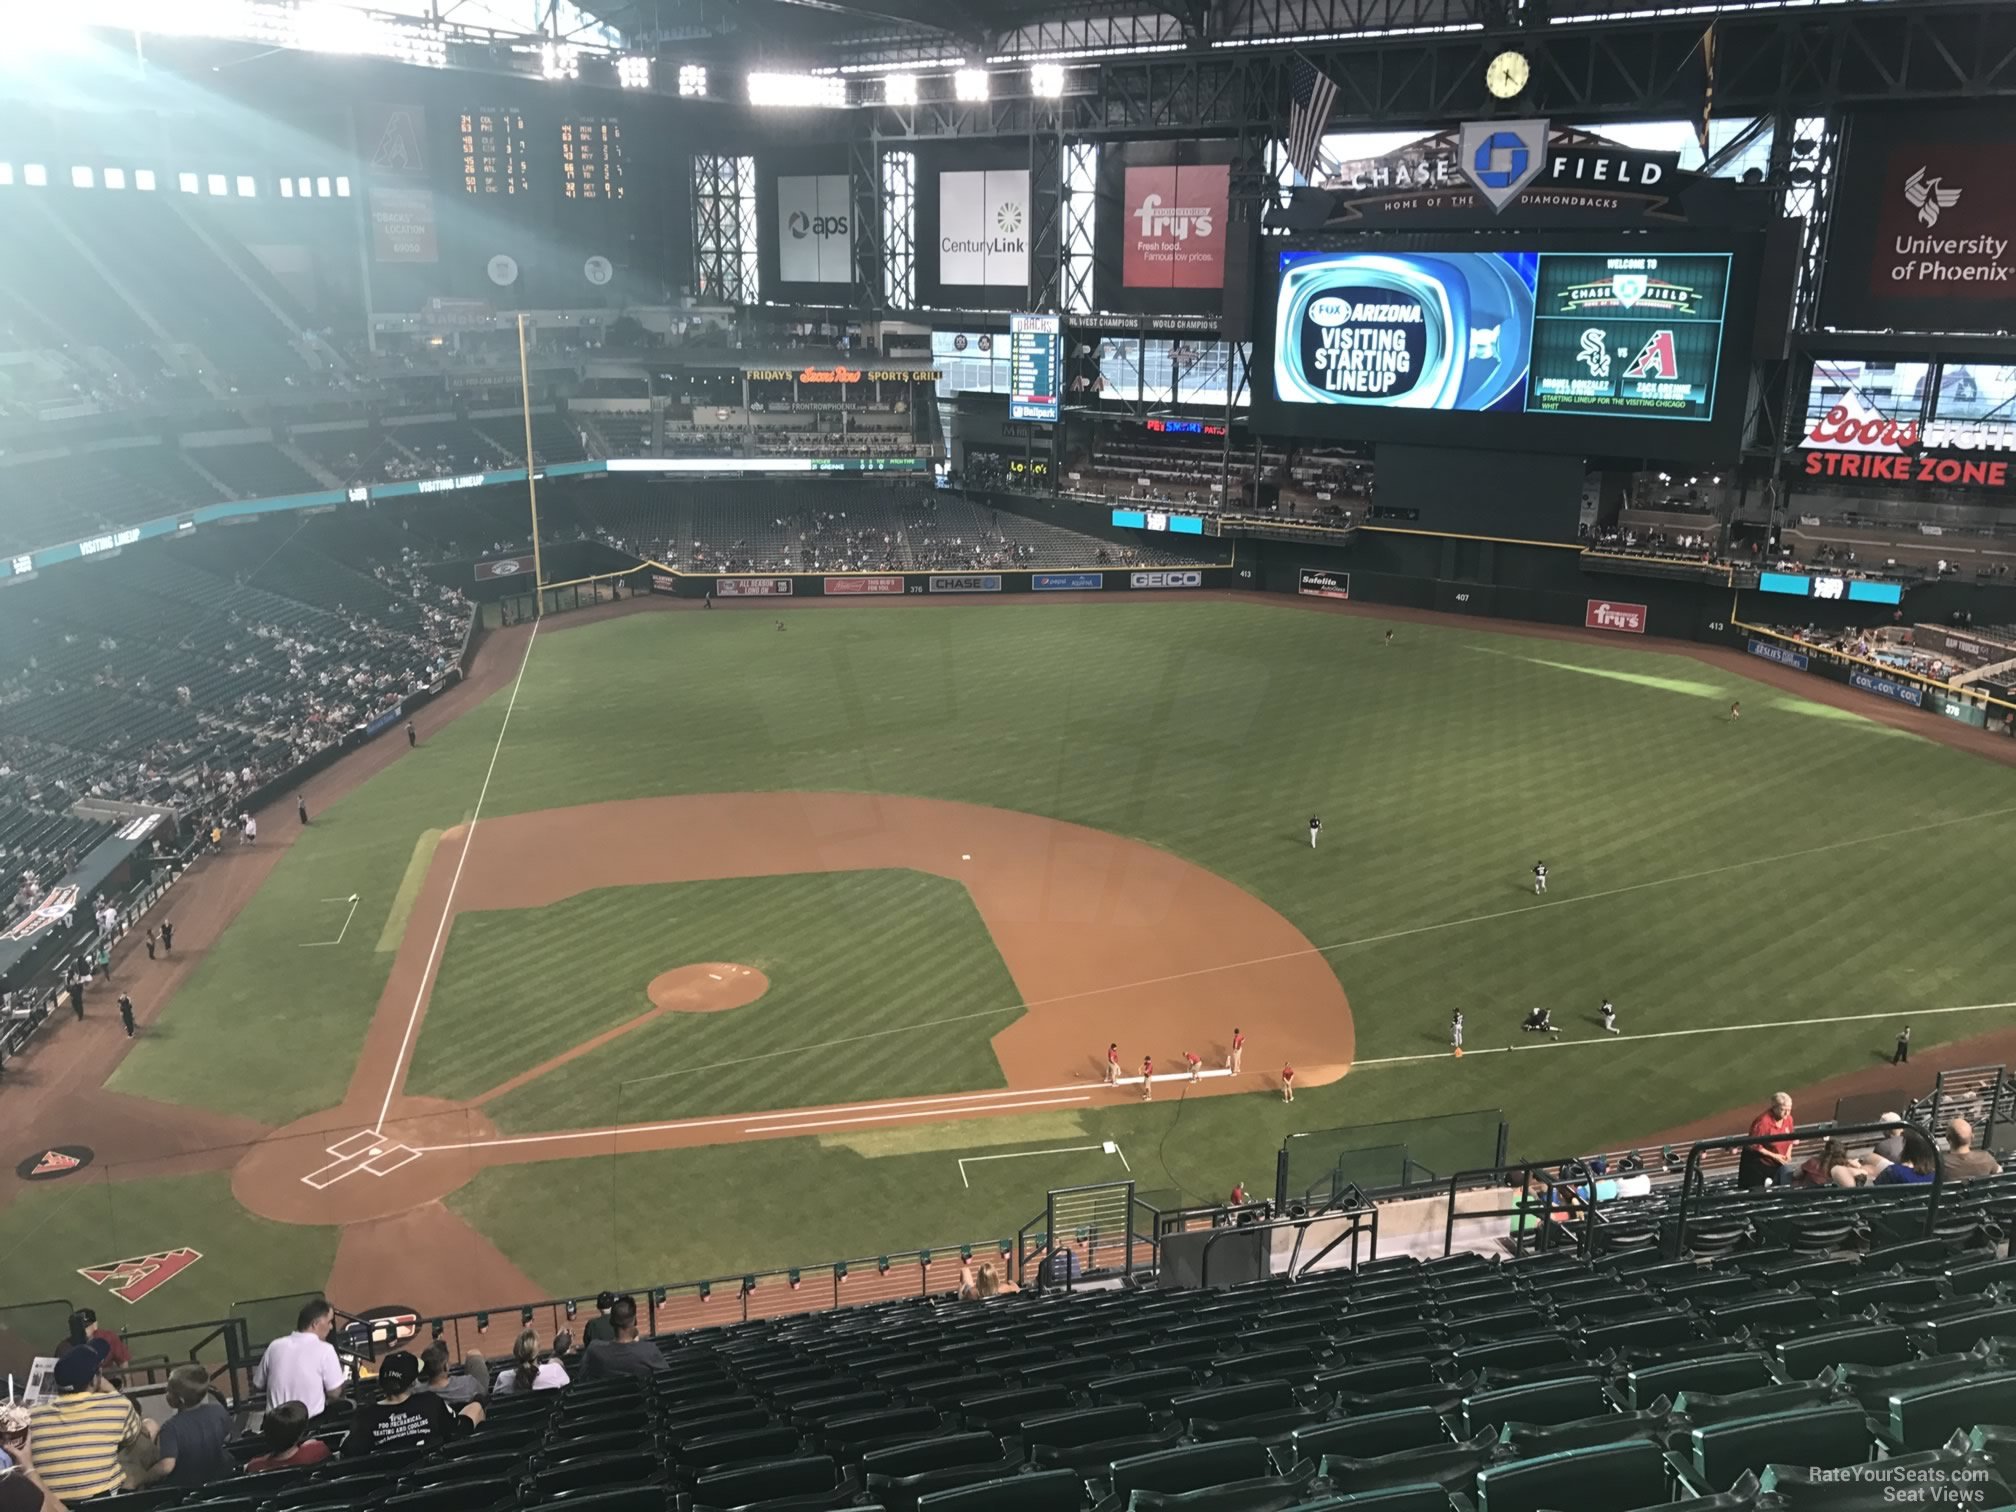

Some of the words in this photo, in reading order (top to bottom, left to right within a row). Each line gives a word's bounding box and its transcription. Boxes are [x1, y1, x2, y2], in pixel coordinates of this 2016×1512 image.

[1352, 160, 1449, 190] CHASE
[1552, 157, 1662, 184] FIELD
[1385, 200, 1418, 211] HOME
[1427, 198, 1440, 206] OF
[1452, 196, 1474, 206] THE
[1521, 195, 1618, 208] DIAMONDBACKS
[1133, 193, 1212, 240] fry's
[812, 215, 848, 239] aps
[942, 238, 1024, 256] CenturyLink
[1138, 242, 1159, 251] Fresh
[1162, 242, 1182, 251] food.
[1896, 234, 2008, 260] University
[1144, 252, 1173, 261] Famous
[1189, 253, 1213, 262] prices.
[1608, 259, 1645, 269] WELCOME
[1892, 260, 1916, 280] of
[1919, 260, 2008, 280] Phoenix
[1571, 288, 1610, 300] CHASE
[1648, 288, 1688, 301] FIELD
[1319, 304, 1341, 314] FOX
[1079, 318, 1097, 326] WEST
[1099, 318, 1138, 327] CHAMPIONS
[1153, 320, 1173, 328] WORLD
[1174, 321, 1218, 329] CHAMPIONS
[1322, 328, 1406, 351] VISITING
[1314, 348, 1410, 372] STARTING
[868, 371, 909, 382] SPORTS
[913, 372, 943, 381] GRILL
[1326, 369, 1396, 392] LINEUP
[1626, 399, 1654, 407] VISITING
[1656, 400, 1686, 408] CHICAGO
[1809, 404, 1920, 447] Coors
[1806, 452, 1913, 481] STRIKE
[1916, 458, 2008, 486] ZONE
[419, 478, 454, 493] VISITING
[456, 475, 484, 489] LINEUP
[80, 535, 114, 556] VISITING
[114, 528, 140, 547] LINEUP
[936, 578, 981, 589] CHASE
[1050, 578, 1066, 586] pepsi
[1134, 574, 1199, 586] GEICO
[1302, 576, 1337, 586] Safelite
[1456, 593, 1469, 602] 407
[1594, 604, 1639, 628] fry's
[1709, 622, 1724, 631] 413
[1856, 676, 1871, 688] COX
[1878, 682, 1894, 695] COX
[1900, 689, 1917, 702] COX
[390, 1414, 422, 1428] MECHANICAL
[408, 1419, 428, 1430] COOLING
